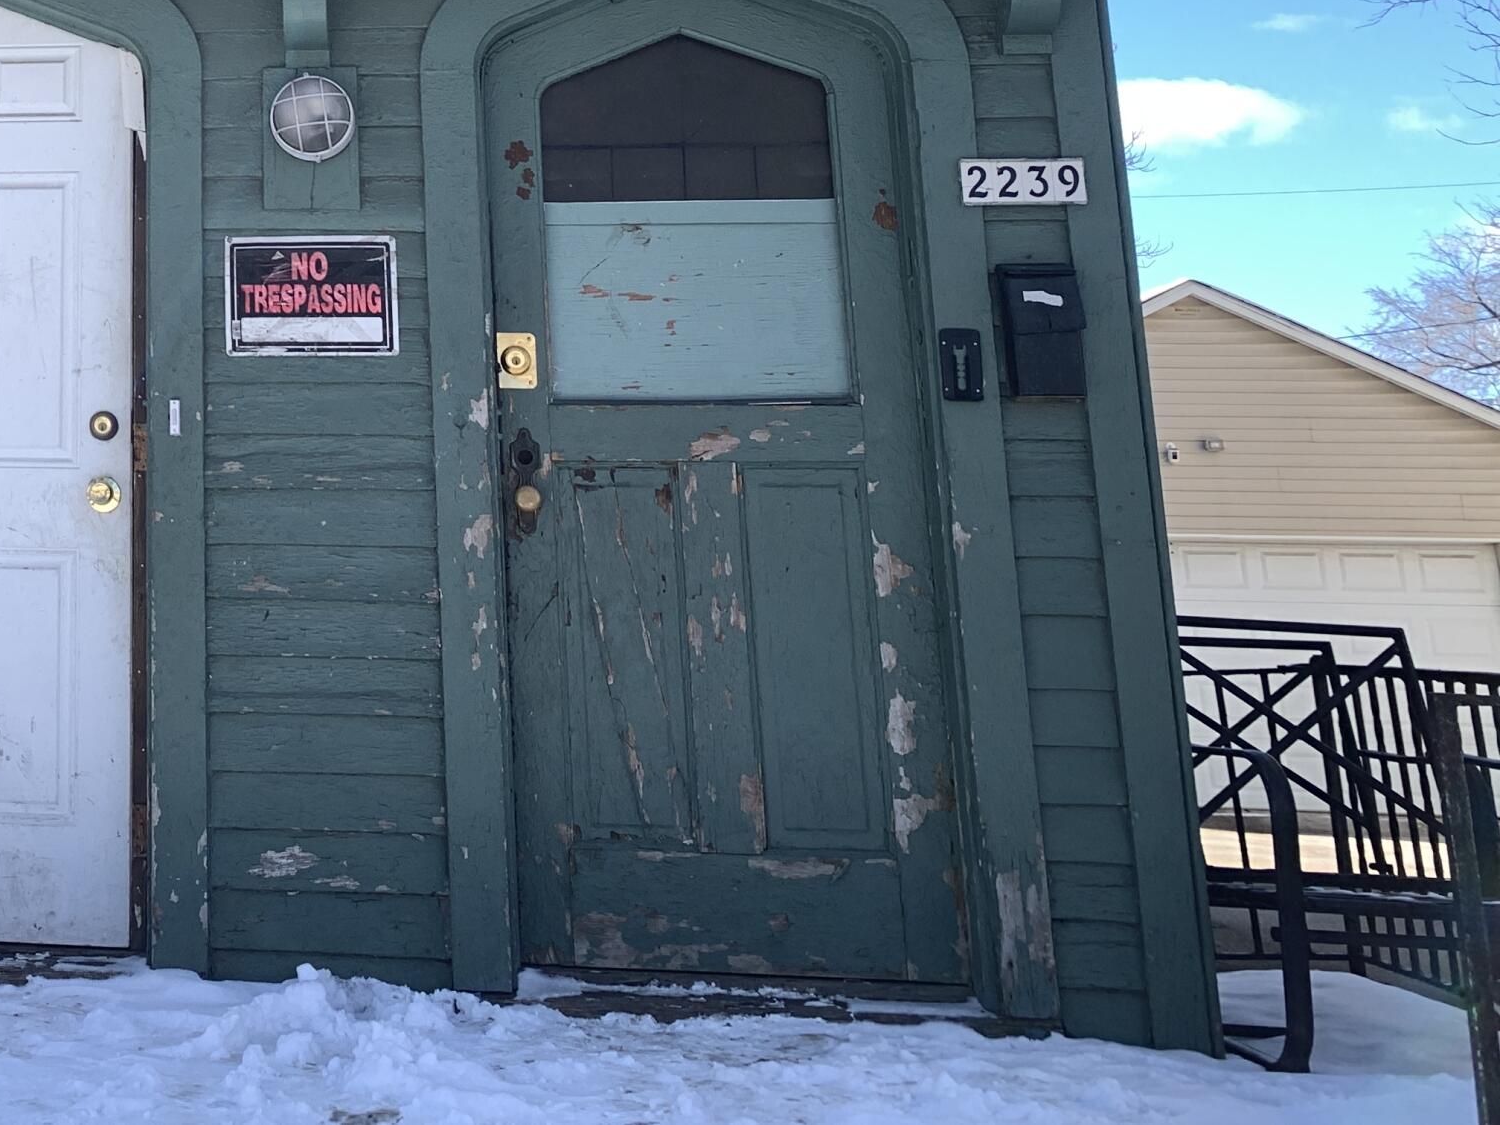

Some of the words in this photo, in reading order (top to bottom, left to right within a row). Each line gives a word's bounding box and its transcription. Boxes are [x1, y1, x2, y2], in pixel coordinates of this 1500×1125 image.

[967, 164, 1080, 198] 2239
[290, 250, 328, 281] NO
[240, 283, 383, 314] TRESPASSING
